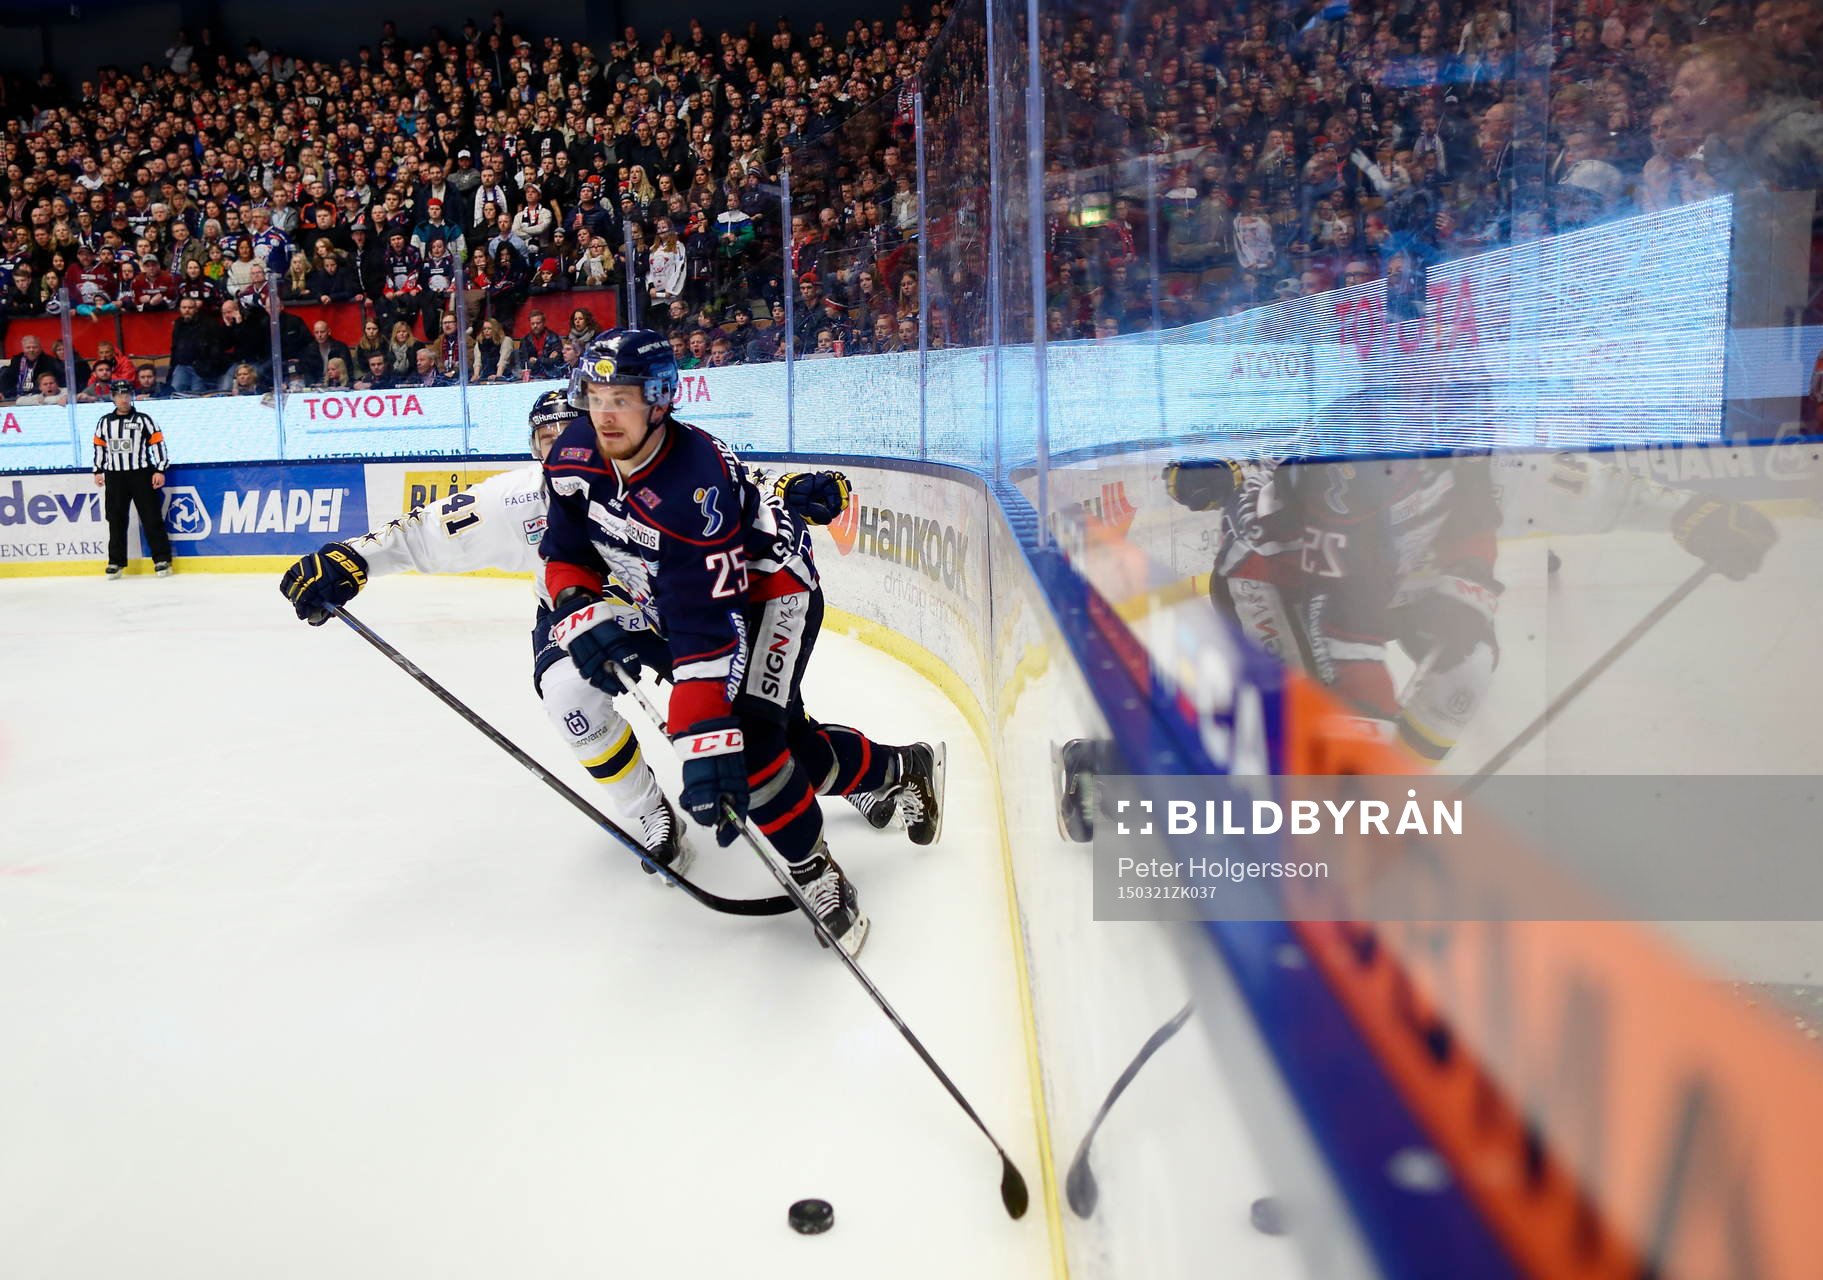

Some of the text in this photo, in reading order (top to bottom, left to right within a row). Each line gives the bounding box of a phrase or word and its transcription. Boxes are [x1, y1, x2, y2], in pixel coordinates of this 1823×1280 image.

[303, 395, 424, 420] TOYOTA
[219, 488, 343, 534] MAPEI
[56, 540, 104, 555] PARK
[705, 544, 749, 599] 25
[761, 633, 791, 698] SIGN
